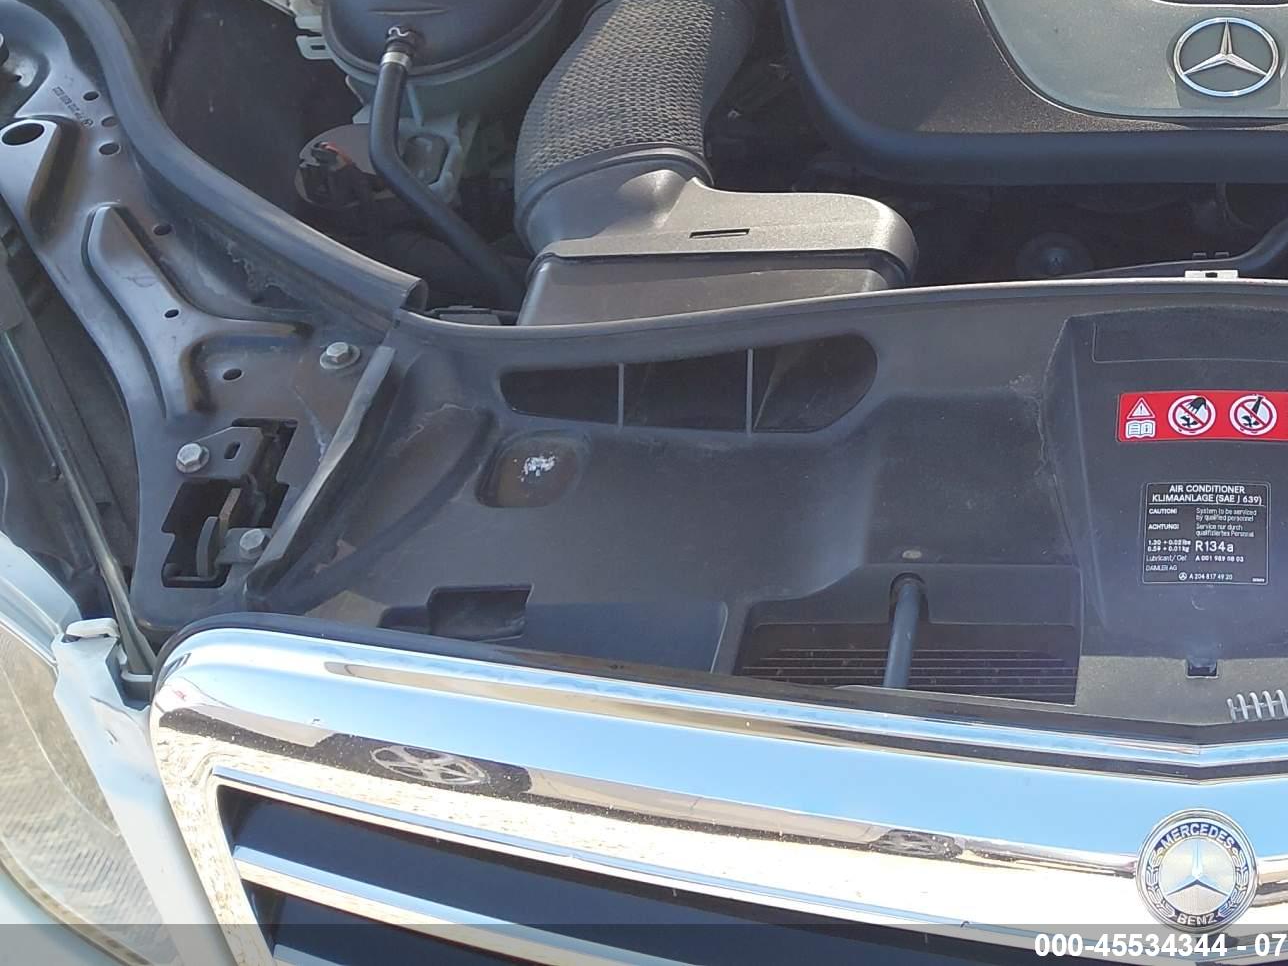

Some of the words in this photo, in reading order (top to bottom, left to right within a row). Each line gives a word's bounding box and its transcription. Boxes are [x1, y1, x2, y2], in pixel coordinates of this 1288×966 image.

[1169, 484, 1184, 493] AIR
[1186, 484, 1245, 494] CONDITIONER
[1152, 494, 1214, 503] KLIMAANLAGE
[1216, 494, 1235, 504] (SAE
[1236, 495, 1240, 504] J
[1242, 495, 1262, 505] 639)
[1196, 507, 1217, 515] System
[1204, 514, 1226, 522] qualified
[1196, 522, 1216, 530] Service
[1227, 523, 1243, 531] durch
[1195, 541, 1234, 552] R134a
[1160, 822, 1236, 850] MERCEDES
[1176, 912, 1218, 927] BENZ
